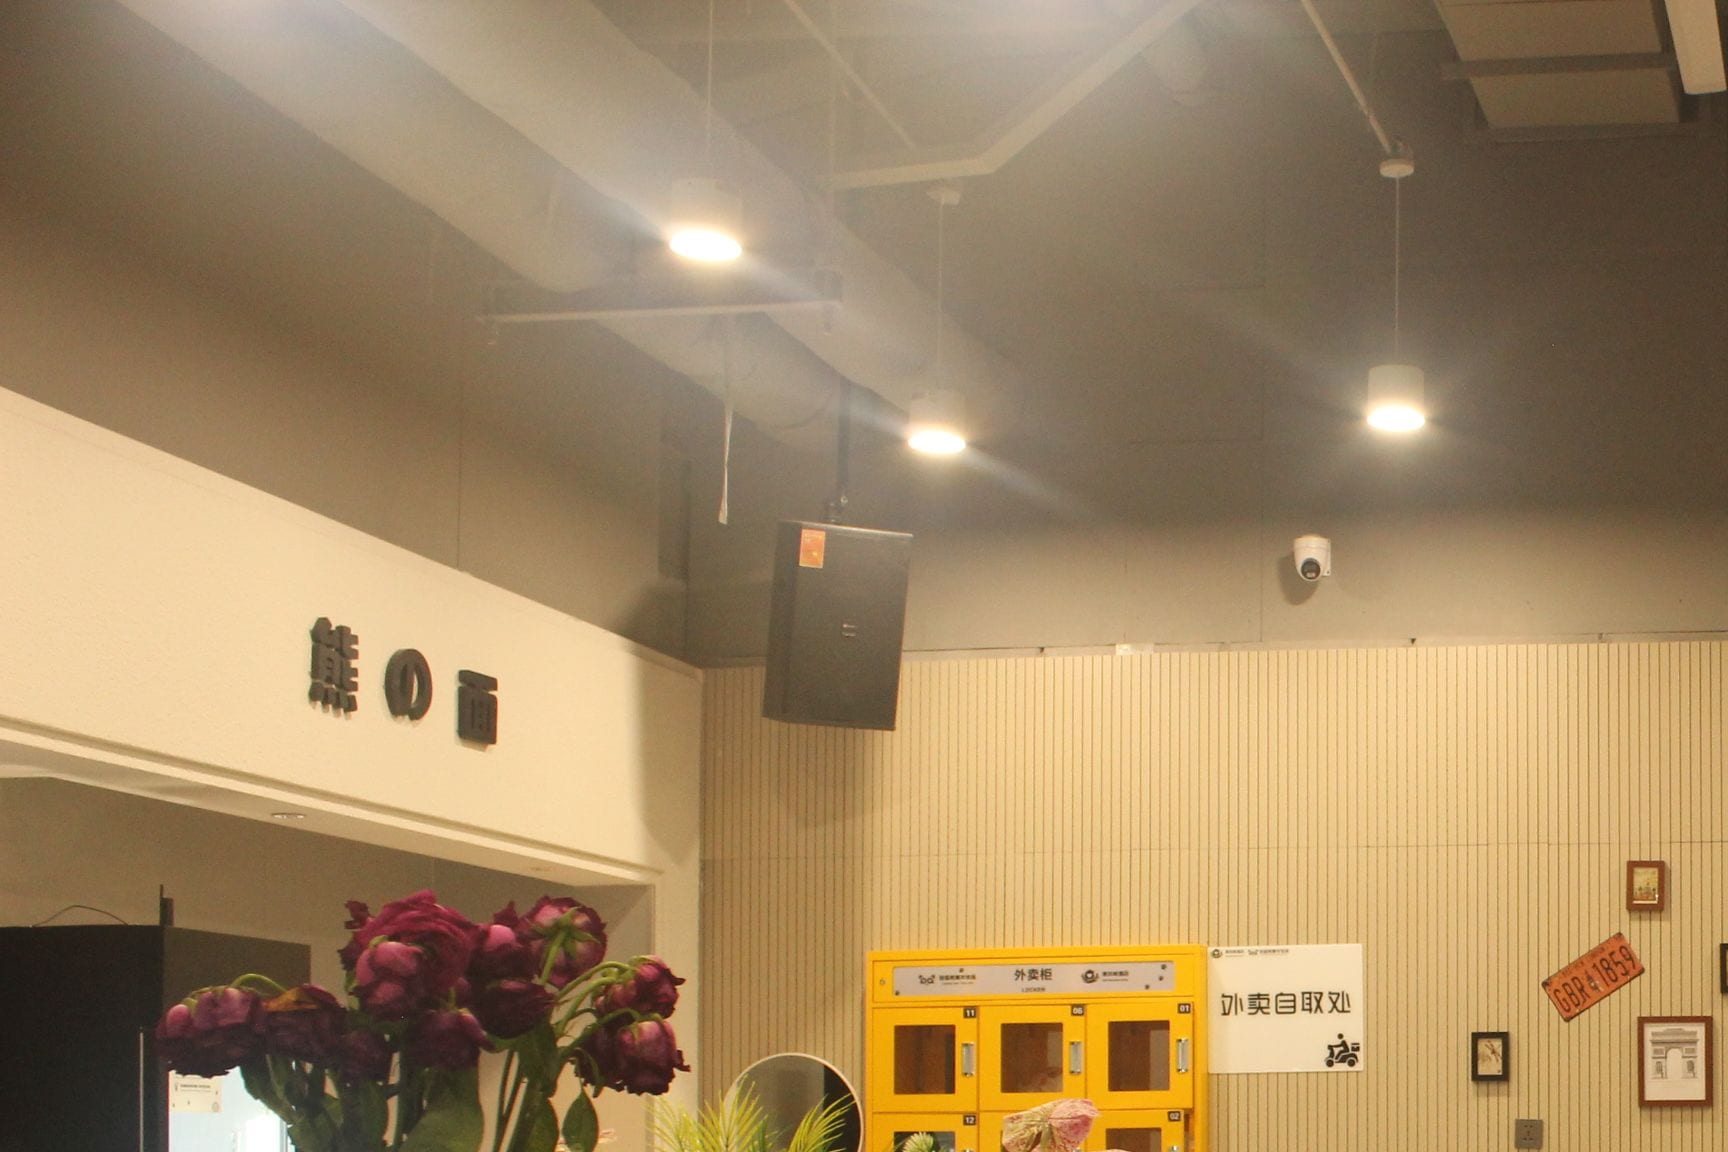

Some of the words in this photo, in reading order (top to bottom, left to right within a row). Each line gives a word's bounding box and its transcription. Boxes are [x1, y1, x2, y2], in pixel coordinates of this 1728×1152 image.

[1014, 968, 1052, 981] 外卖柜
[1553, 976, 1591, 1013] GBR
[1592, 945, 1636, 988] 1859
[1221, 990, 1351, 1016] 外卖自取处
[1179, 1004, 1190, 1012] 01
[966, 1009, 975, 1017] 11
[965, 1116, 976, 1124] 12
[1169, 1112, 1180, 1120] 02
